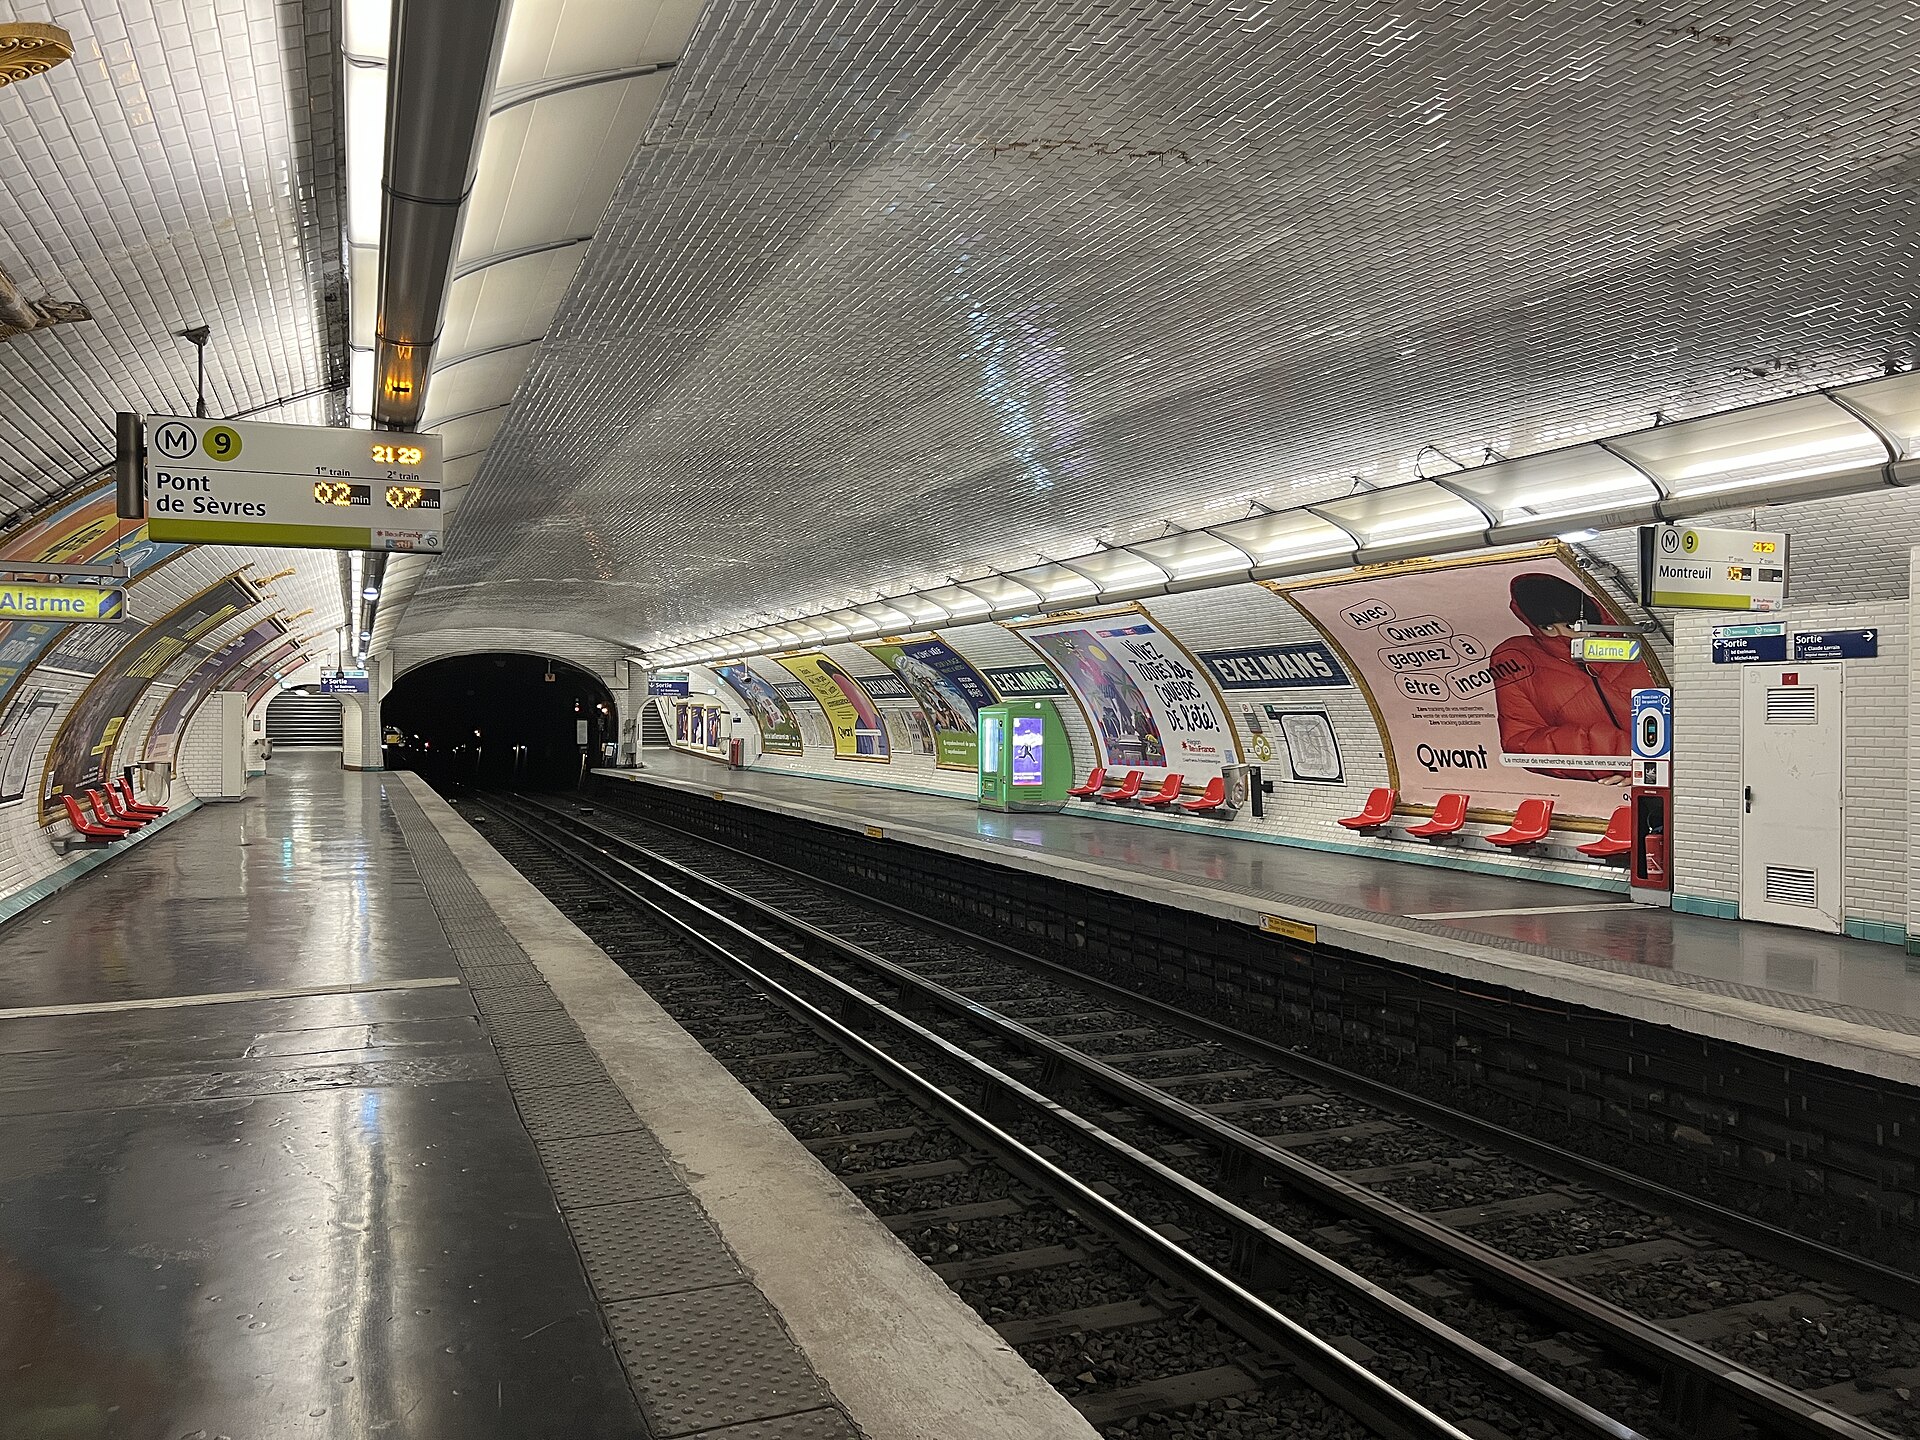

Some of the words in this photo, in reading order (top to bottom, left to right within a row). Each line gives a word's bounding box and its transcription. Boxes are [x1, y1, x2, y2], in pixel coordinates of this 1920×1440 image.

[214, 432, 231, 455] 9
[315, 466, 327, 475] 1er
[387, 471, 397, 479] 2e
[156, 472, 211, 492] Pont
[314, 481, 352, 506] 02
[351, 495, 370, 504] min
[385, 485, 422, 510] 07
[421, 499, 440, 508] min
[156, 494, 185, 513] de
[193, 496, 266, 517] Sèvres
[1686, 535, 1694, 550] 9
[1659, 565, 1712, 579] Montreuil
[0, 592, 85, 612] Alarme
[1349, 605, 1388, 625] Avec
[1386, 620, 1446, 641] Qwant
[1795, 635, 1823, 644] Sortie
[1120, 639, 1164, 661] VIVEZ
[1387, 648, 1451, 669] gagnez
[1458, 638, 1477, 655] à
[1588, 645, 1624, 657] Alarme
[1723, 638, 1748, 648] Sortie
[1128, 659, 1172, 681] TOUTES
[1212, 652, 1333, 682] EXELMANS
[1404, 677, 1441, 695] être
[1451, 658, 1526, 693] inconnu.
[991, 670, 1059, 692] EXELMANS
[1154, 681, 1201, 708] COULEURS
[1165, 710, 1184, 731] DE
[1416, 743, 1488, 773] Qwant
[1566, 759, 1575, 767] qui
